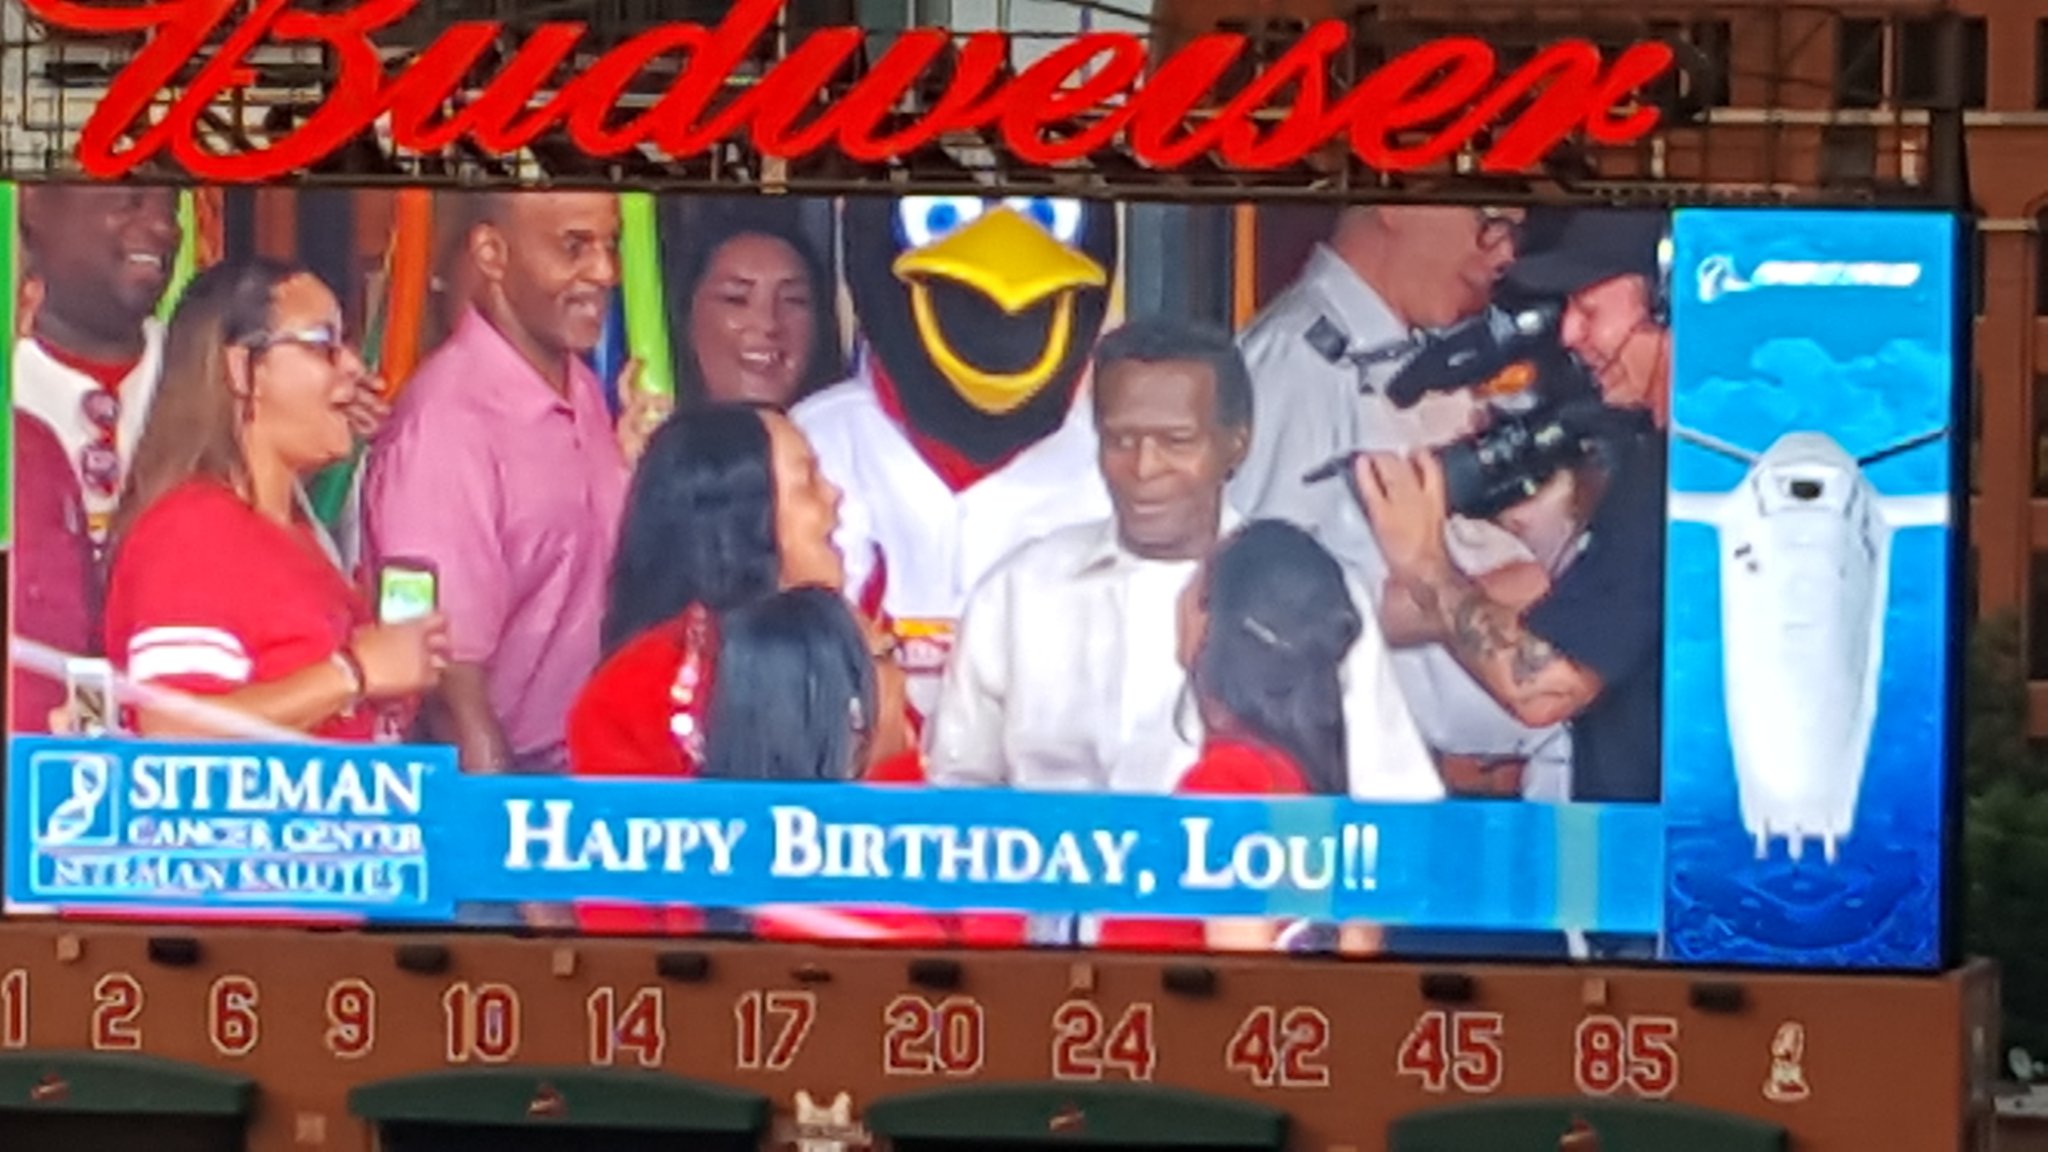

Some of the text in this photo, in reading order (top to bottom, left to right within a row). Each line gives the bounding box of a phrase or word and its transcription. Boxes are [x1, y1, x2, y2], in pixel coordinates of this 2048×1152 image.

[22, 0, 1674, 181] Budweiser
[129, 755, 423, 814] SITEMAN
[504, 799, 1379, 897] HAPPY BIRTHDAY, LOU!!
[2, 969, 1679, 1099] 1 2 6 9 10 14 17 20 24 42 45 85
